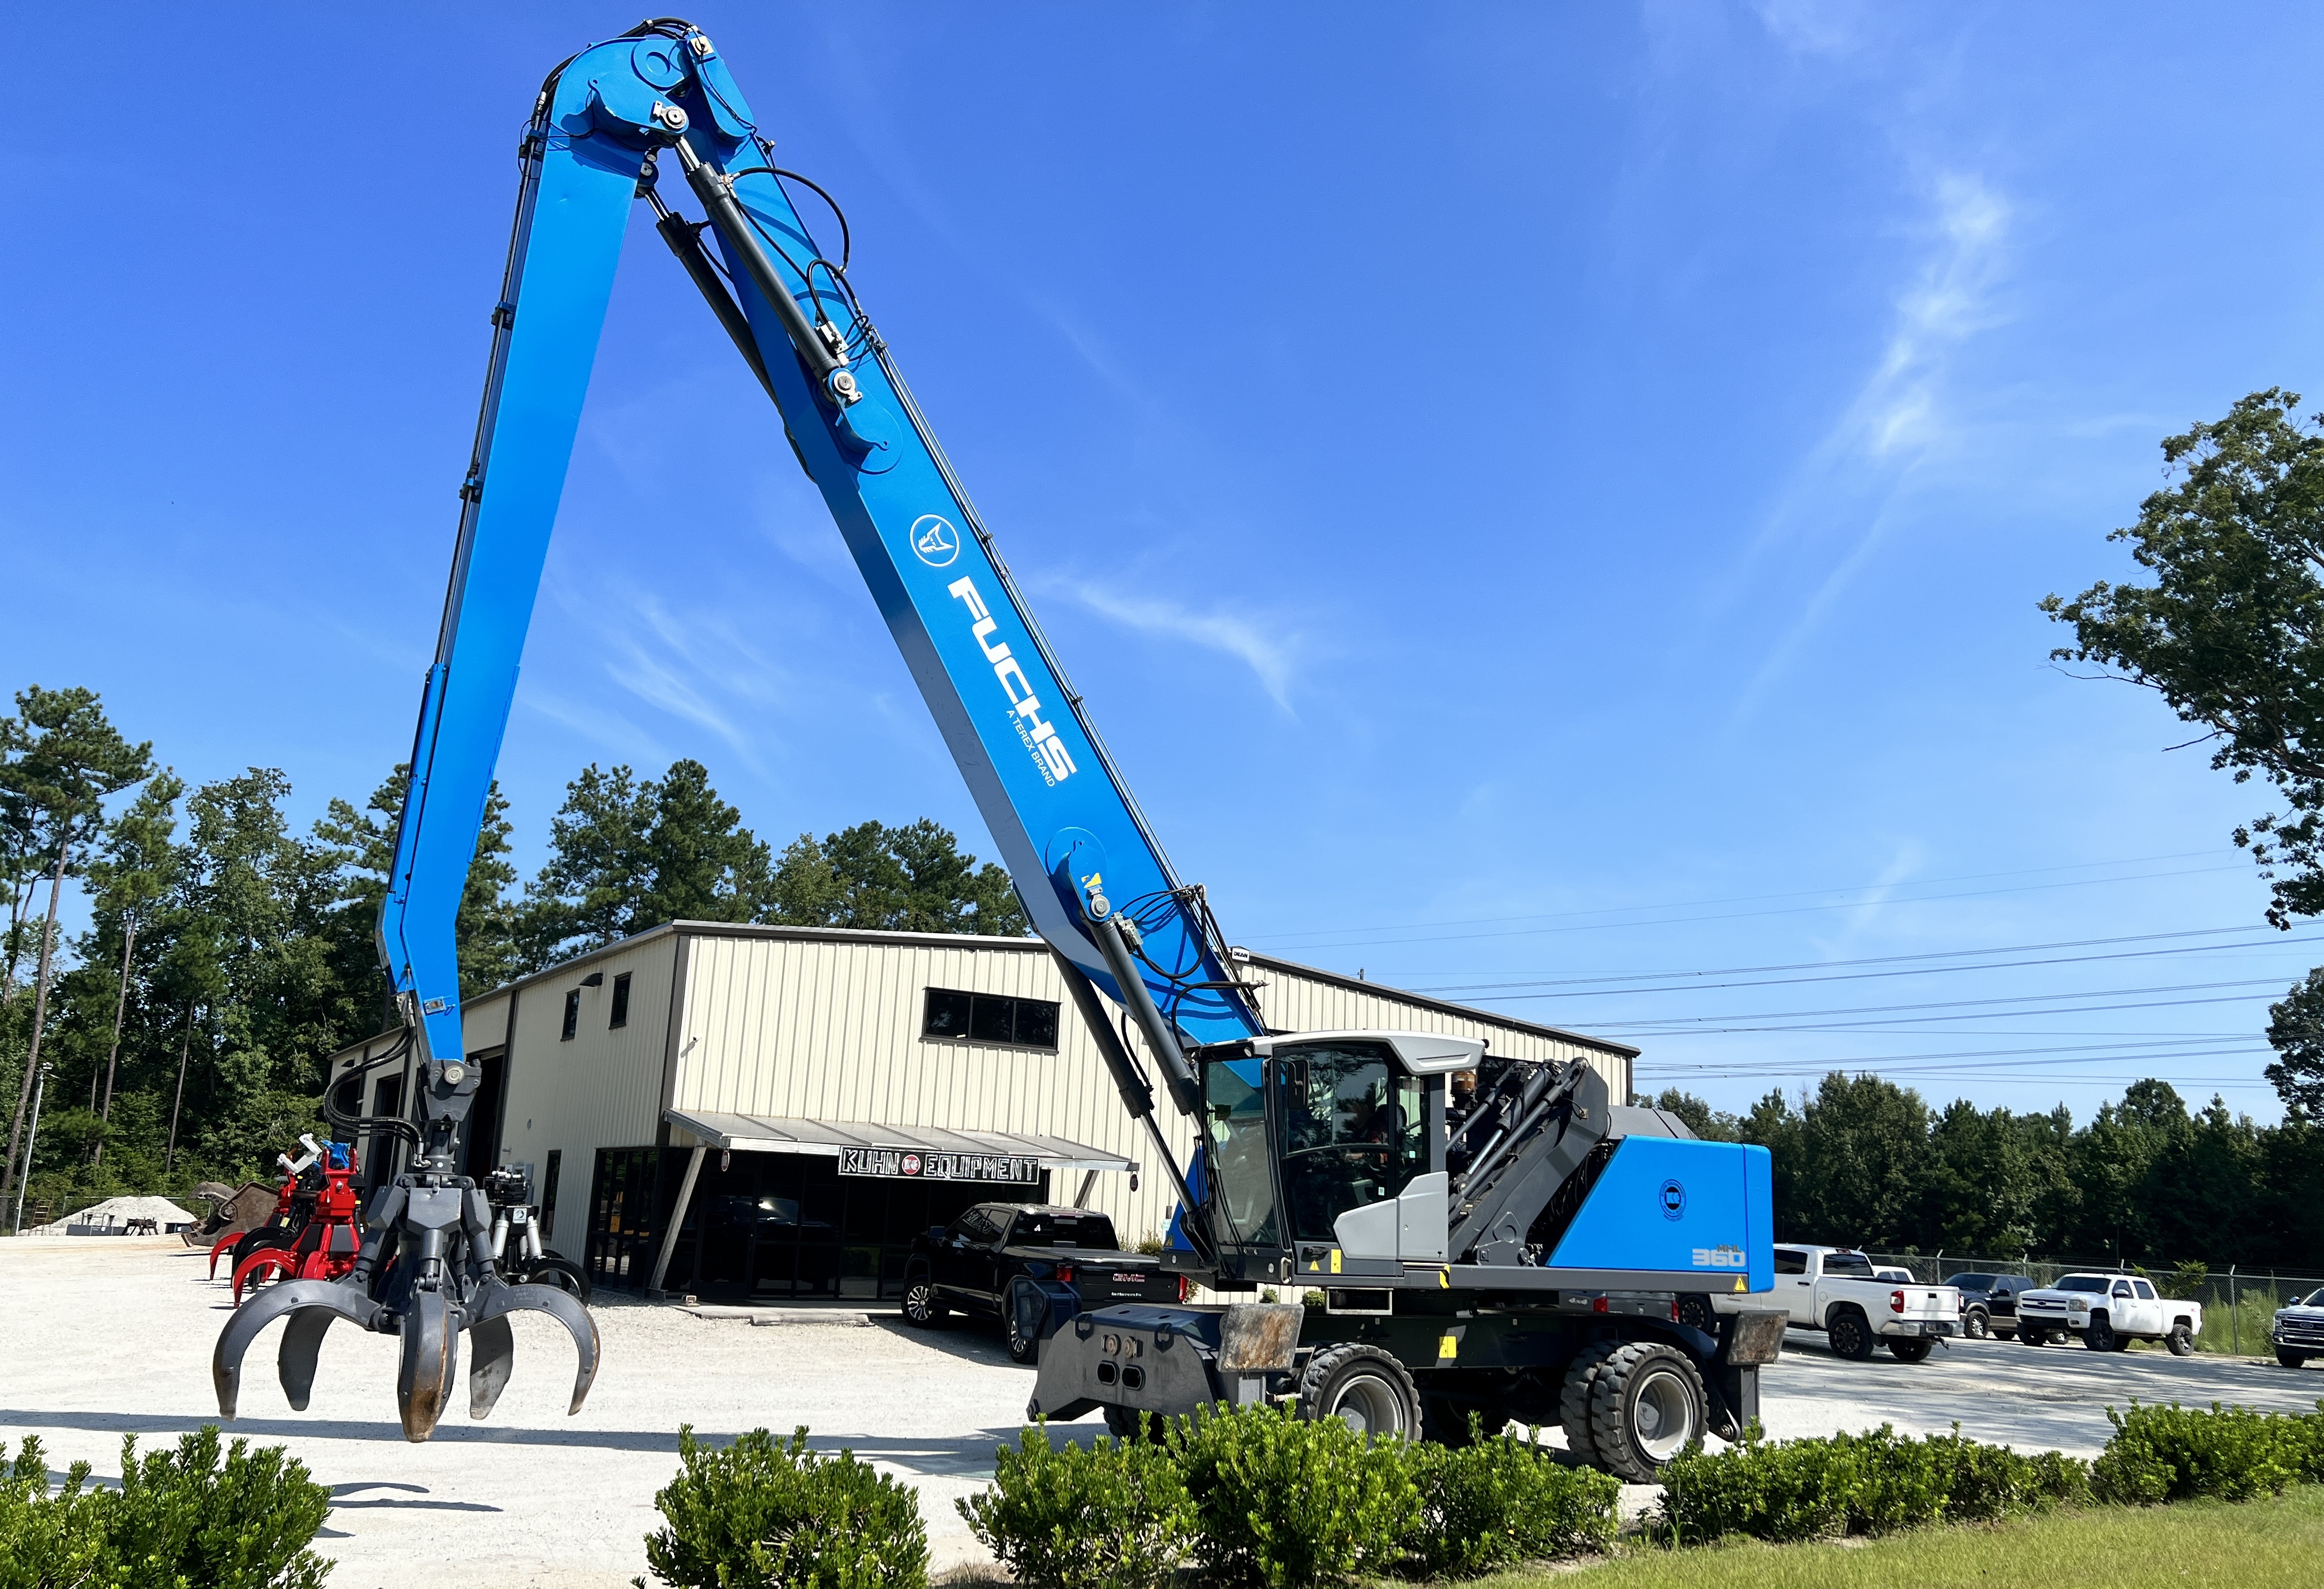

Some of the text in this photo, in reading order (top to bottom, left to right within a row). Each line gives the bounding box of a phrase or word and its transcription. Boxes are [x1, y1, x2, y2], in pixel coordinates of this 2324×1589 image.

[947, 576, 1077, 782] FUCHS
[1006, 710, 1055, 787] A TEREX BRAND
[842, 1149, 900, 1175] KUHN
[923, 1154, 1037, 1181] EQUIPMENT
[1692, 1248, 1745, 1267] 360
[1716, 1244, 1742, 1252] MHL
[1112, 1273, 1145, 1282] GMC
